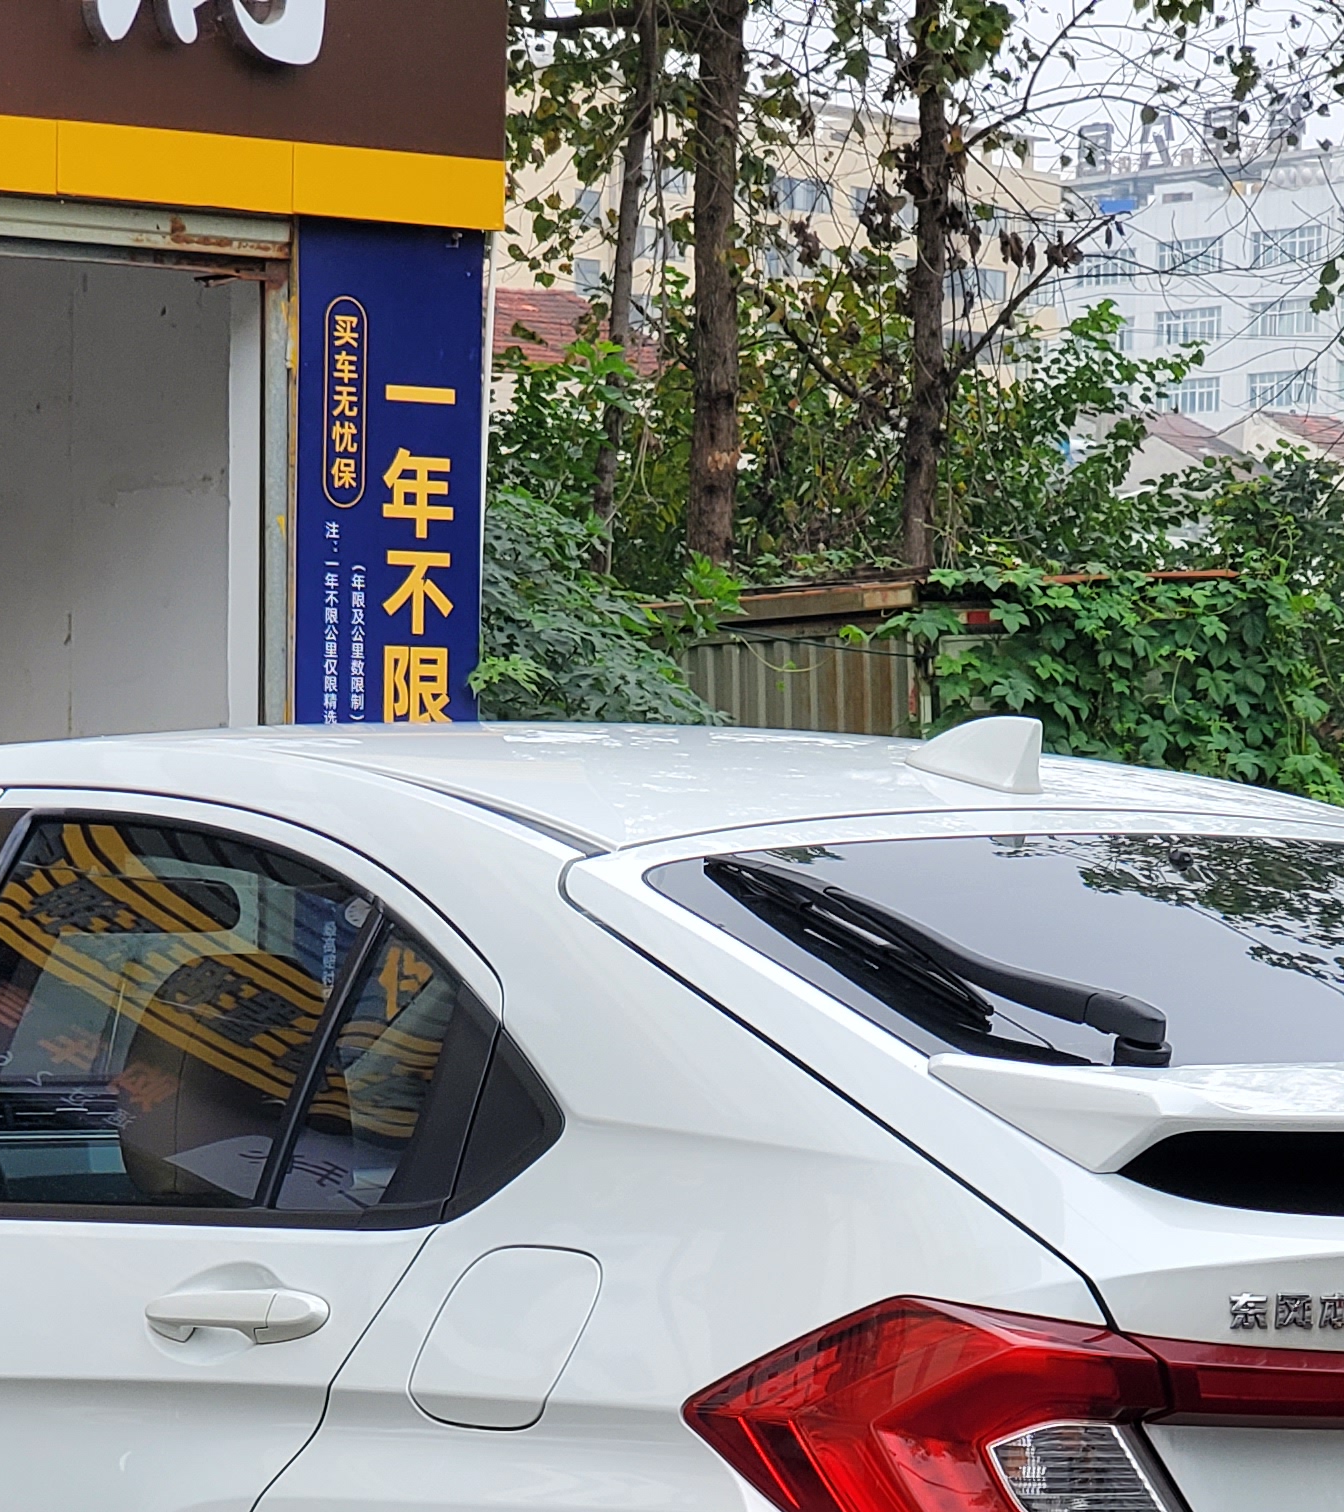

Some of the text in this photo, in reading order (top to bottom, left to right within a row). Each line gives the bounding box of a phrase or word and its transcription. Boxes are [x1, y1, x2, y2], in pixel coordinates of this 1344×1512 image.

[331, 315, 359, 489] 买车无忧保
[382, 384, 456, 723] 一年不限
